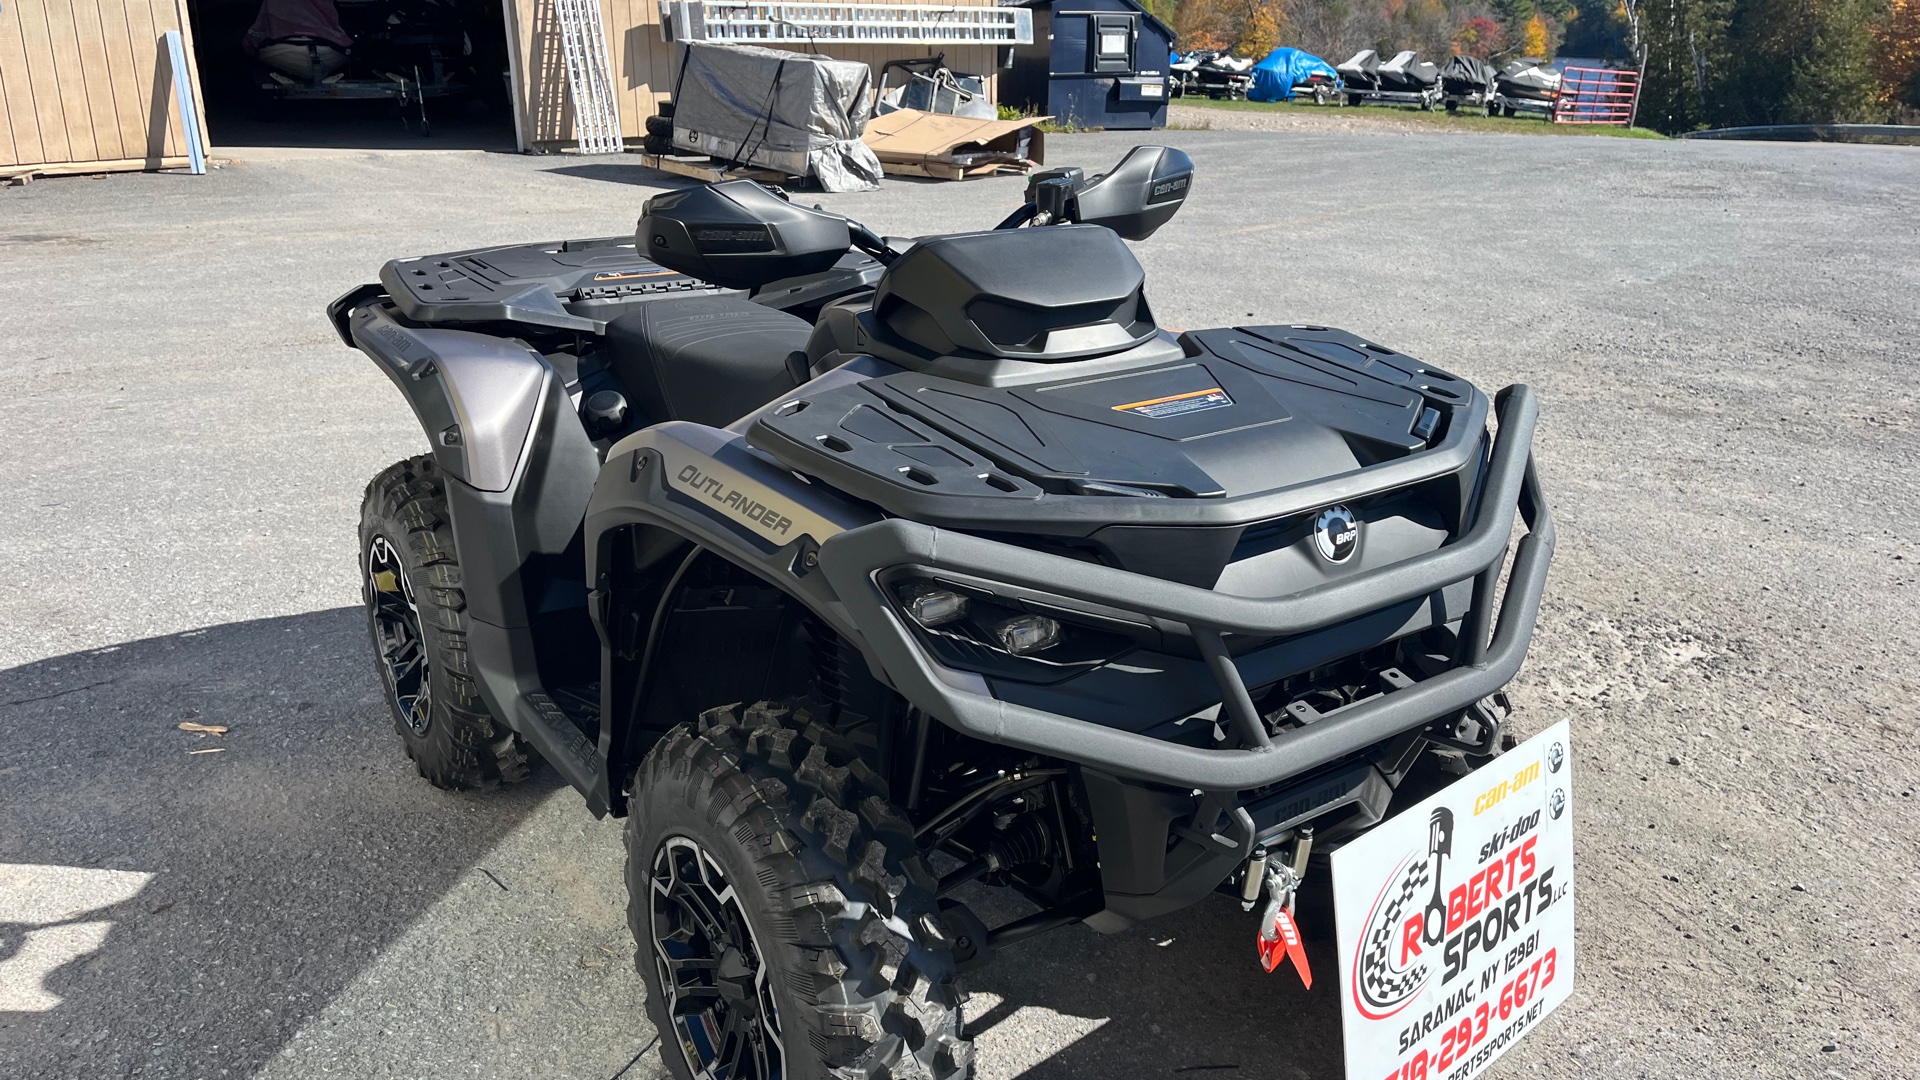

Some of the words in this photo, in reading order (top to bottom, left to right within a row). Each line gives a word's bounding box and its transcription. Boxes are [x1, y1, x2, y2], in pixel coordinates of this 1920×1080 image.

[1154, 178, 1188, 196] can-am
[697, 229, 766, 241] can-am
[376, 324, 412, 352] can-am
[677, 464, 793, 536] OUTLANDER
[1336, 529, 1356, 545] BRP
[1473, 761, 1540, 817] can-am
[1477, 808, 1541, 865] ski-doo
[1441, 865, 1555, 987] SPORTS
[1383, 947, 1557, 1080] 18-293-6673
[1397, 979, 1476, 1056] SARANAC,
[1480, 959, 1501, 994] NY
[1504, 929, 1540, 976] 12981
